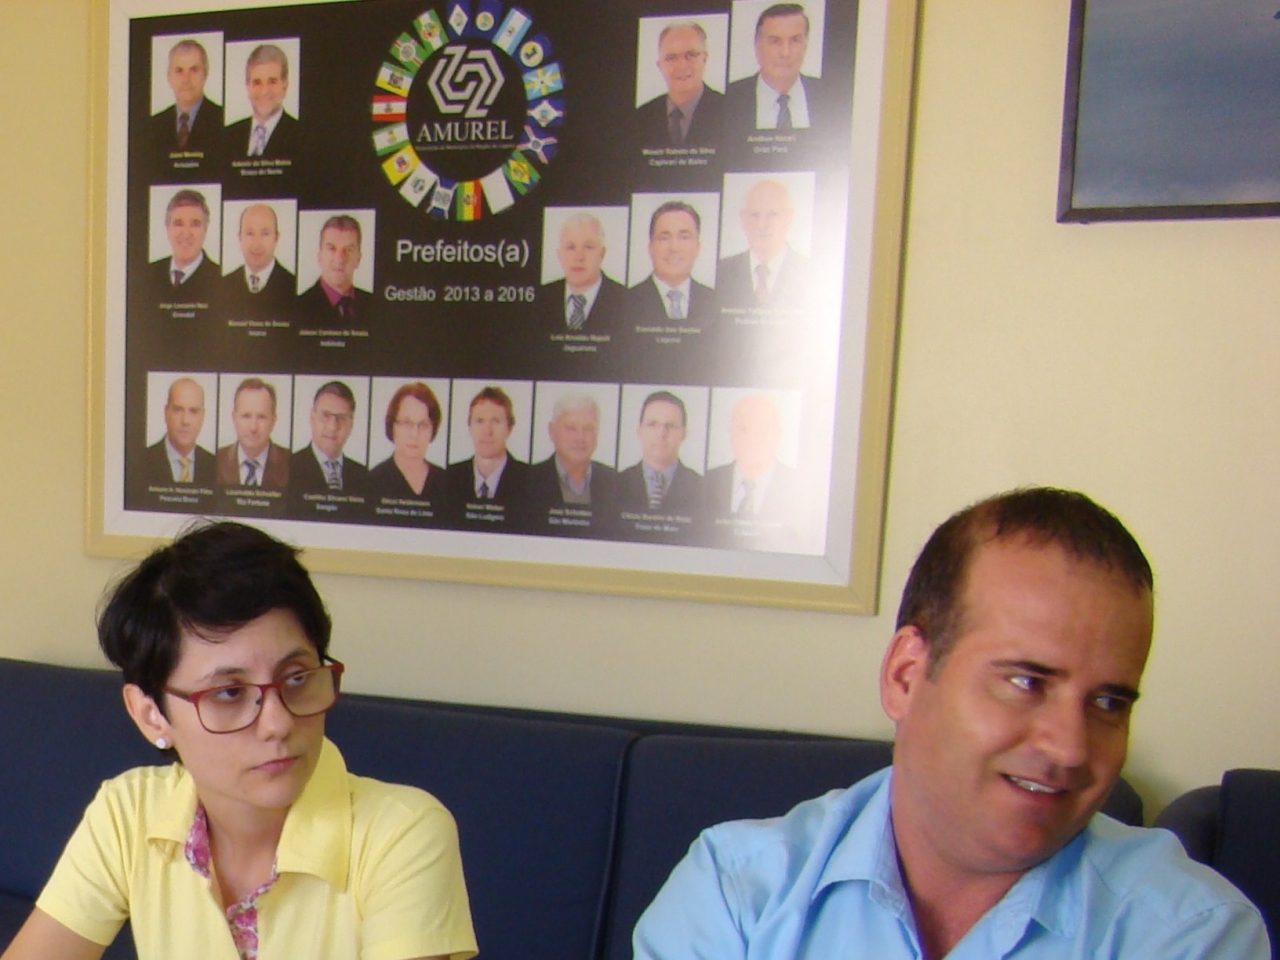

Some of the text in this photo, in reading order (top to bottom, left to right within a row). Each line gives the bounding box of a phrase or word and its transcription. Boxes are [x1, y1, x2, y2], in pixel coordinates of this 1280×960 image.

[417, 119, 515, 142] AMUREL
[396, 239, 530, 268] Prefeitos(a)
[384, 285, 535, 302] Gestão 2013 a 2016
